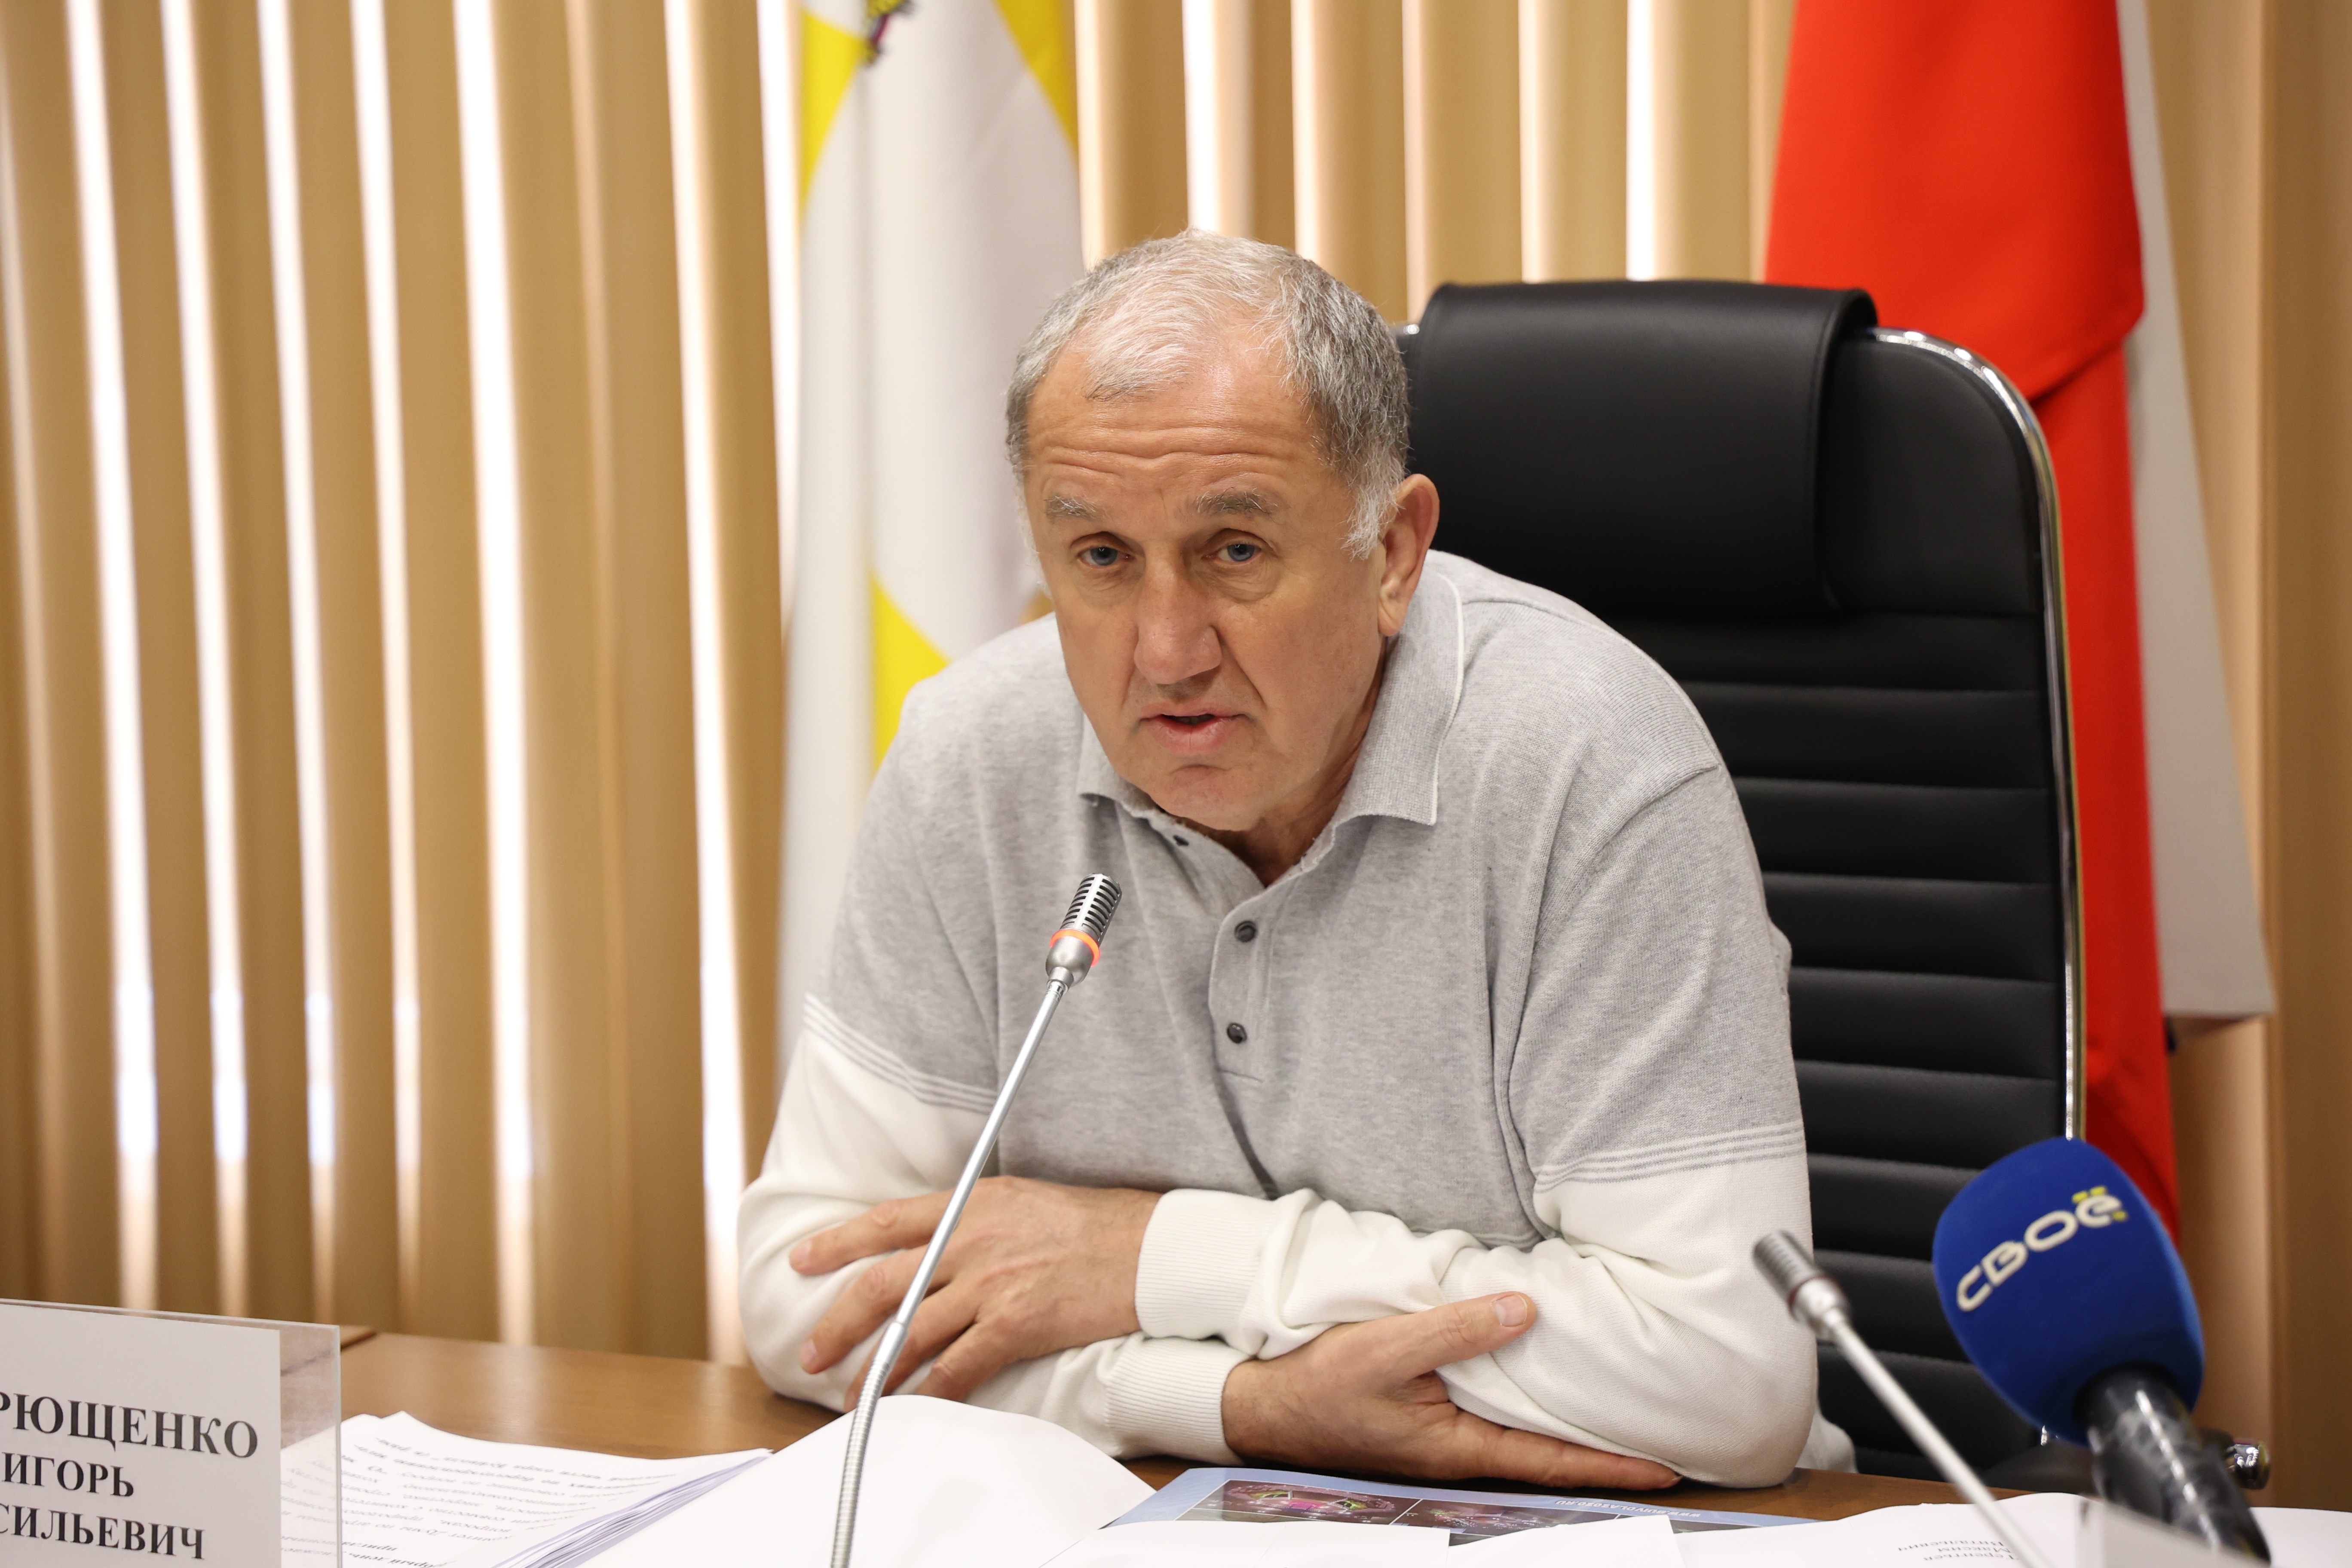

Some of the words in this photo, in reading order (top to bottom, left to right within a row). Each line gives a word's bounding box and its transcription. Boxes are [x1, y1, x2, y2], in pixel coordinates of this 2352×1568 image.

[2, 1452, 134, 1497] ИГОРЬ
[1898, 1540, 2005, 1551] Витальевич
[1923, 1553, 2020, 1561] Терентьев
